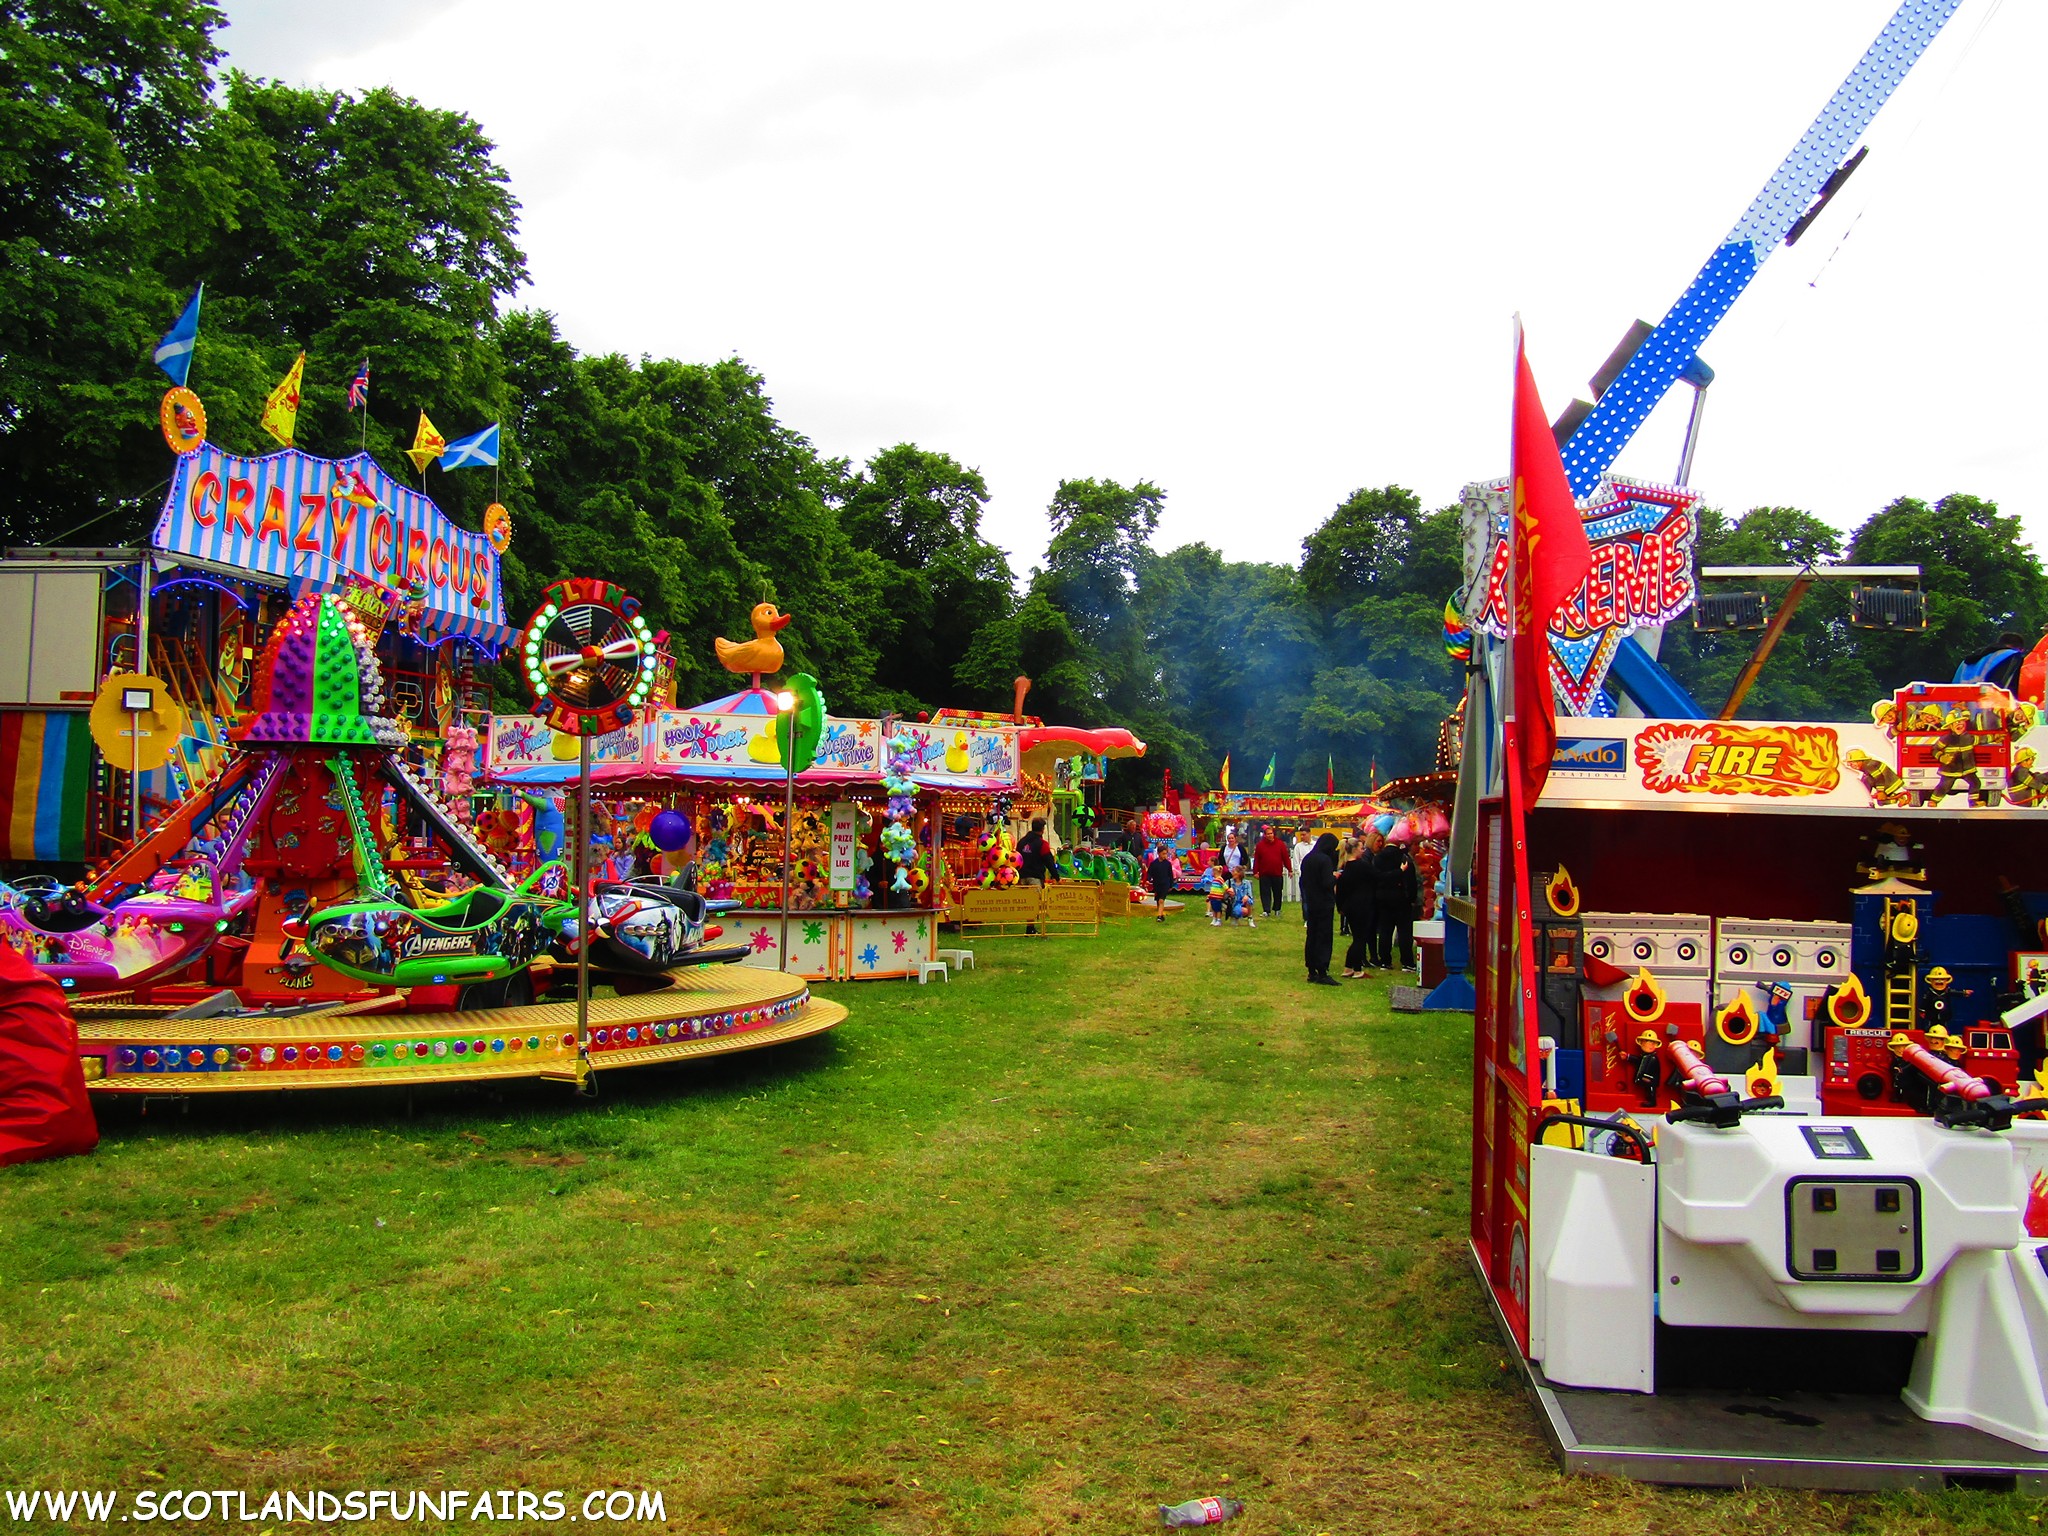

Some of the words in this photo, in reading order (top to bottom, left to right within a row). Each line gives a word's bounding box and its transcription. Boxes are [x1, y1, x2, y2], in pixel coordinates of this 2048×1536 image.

[192, 470, 358, 562] CRAZY
[370, 512, 490, 600] CIRCUS
[547, 577, 643, 618] FLYING
[534, 697, 634, 735] PLANES
[497, 727, 524, 751] HOOK
[524, 729, 552, 755] DUCK
[663, 723, 706, 747] HOOK
[690, 740, 703, 758] A
[704, 728, 748, 754] DUCK
[815, 733, 856, 758] EVERY
[842, 745, 875, 768] TIME
[921, 740, 946, 764] DUCK
[1682, 744, 1782, 776] FIRE
[1244, 797, 1319, 813] TREASURED
[835, 822, 851, 830] ANY
[833, 834, 853, 843] PRIZE
[835, 860, 850, 868] LIKE
[405, 933, 473, 957] AVENGERS
[279, 972, 314, 989] PLANES
[1849, 1029, 1887, 1037] RESCUE
